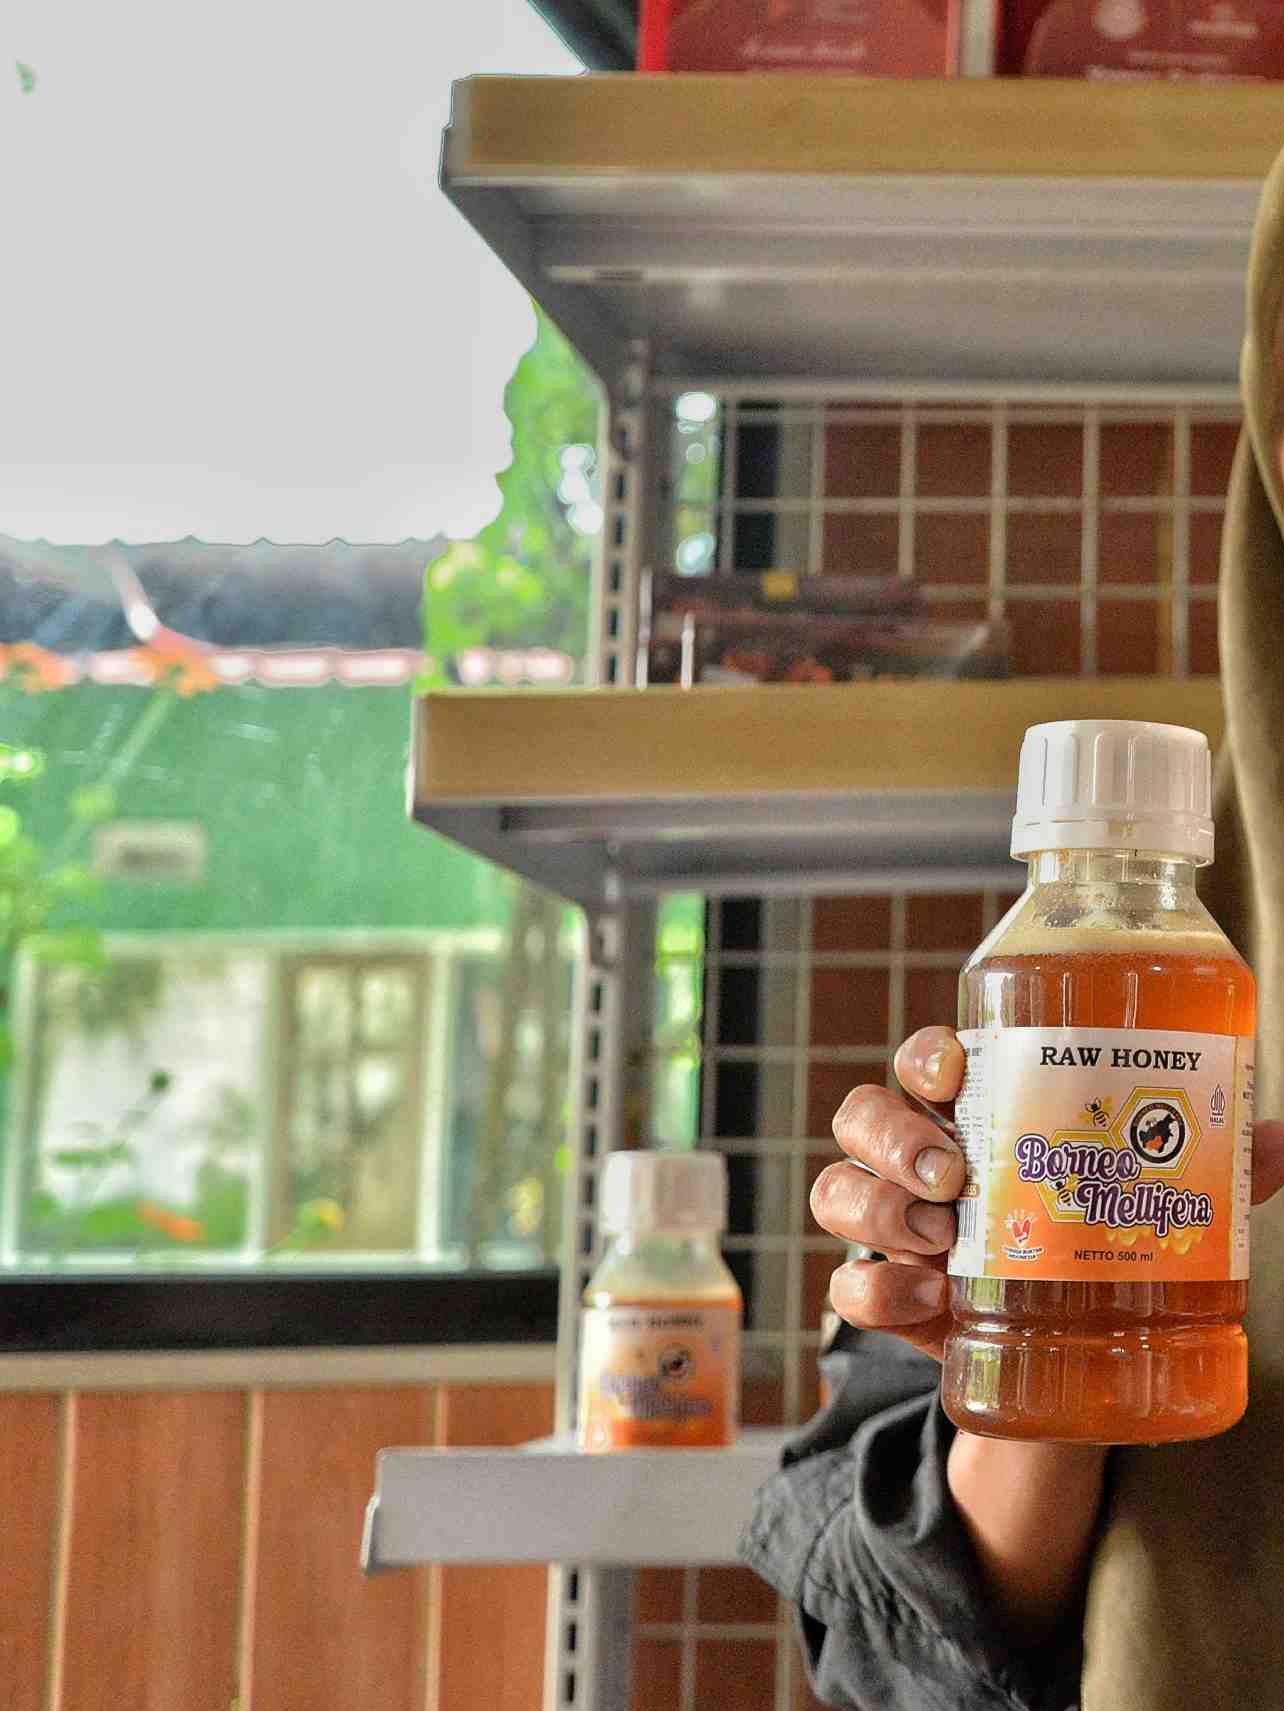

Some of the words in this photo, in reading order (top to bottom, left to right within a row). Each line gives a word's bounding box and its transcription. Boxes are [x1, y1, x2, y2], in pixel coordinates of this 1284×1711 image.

[1040, 1046, 1102, 1067] RAW
[1111, 1048, 1202, 1071] HONEY
[1017, 1135, 1140, 1181] Borneo
[1075, 1182, 1212, 1236] Mellifera
[1074, 1250, 1115, 1260] NETTO
[1117, 1251, 1138, 1261] 500
[1140, 1251, 1153, 1261] ml
